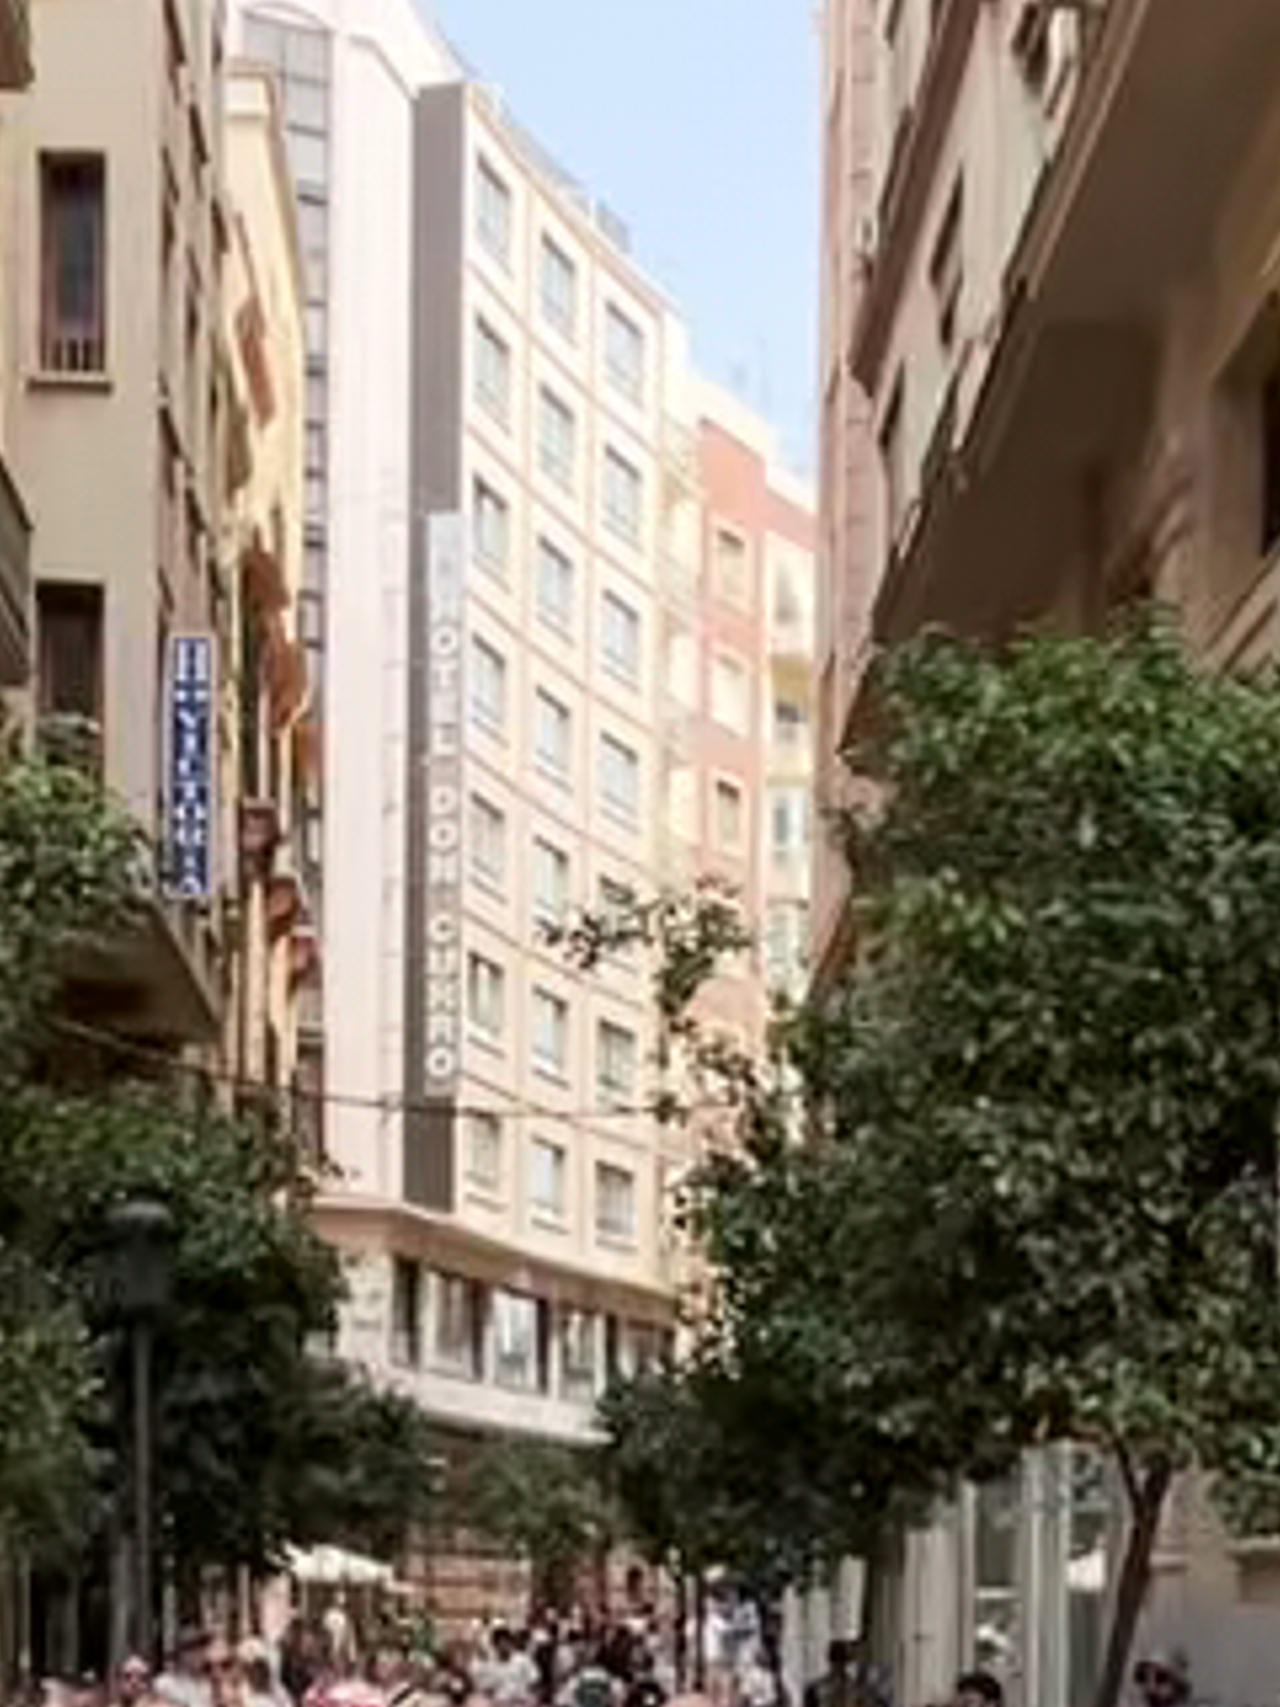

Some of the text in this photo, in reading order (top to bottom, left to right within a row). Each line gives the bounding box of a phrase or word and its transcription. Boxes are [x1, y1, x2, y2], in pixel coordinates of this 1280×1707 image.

[425, 596, 459, 1079] HOTEL DON CURRO
